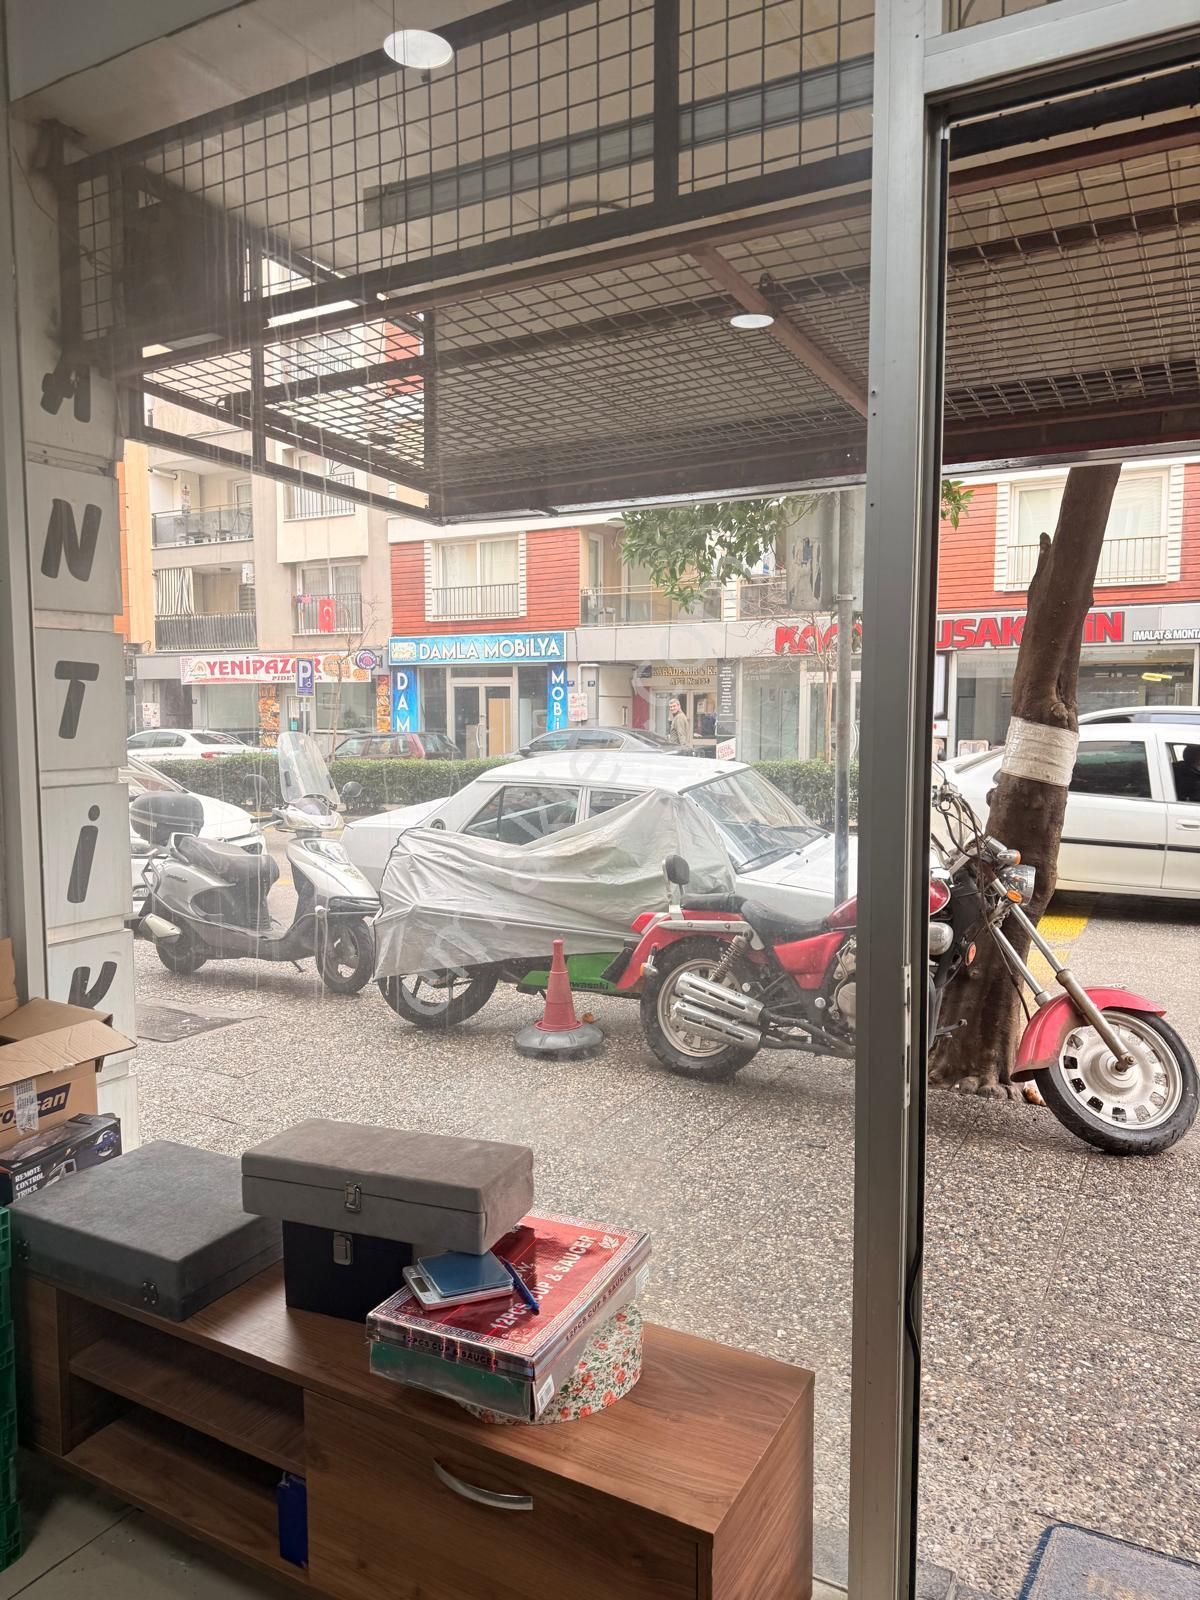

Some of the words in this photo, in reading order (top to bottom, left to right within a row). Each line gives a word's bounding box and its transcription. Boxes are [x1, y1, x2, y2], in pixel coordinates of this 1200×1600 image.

[419, 641, 479, 660] DAMLA
[206, 656, 322, 676] YENİPAZR
[298, 660, 312, 687] P
[15, 1165, 41, 1182] REMOTE
[15, 1172, 45, 1191] CONTROL
[553, 1235, 597, 1273] SAUCER
[545, 1273, 563, 1282] &
